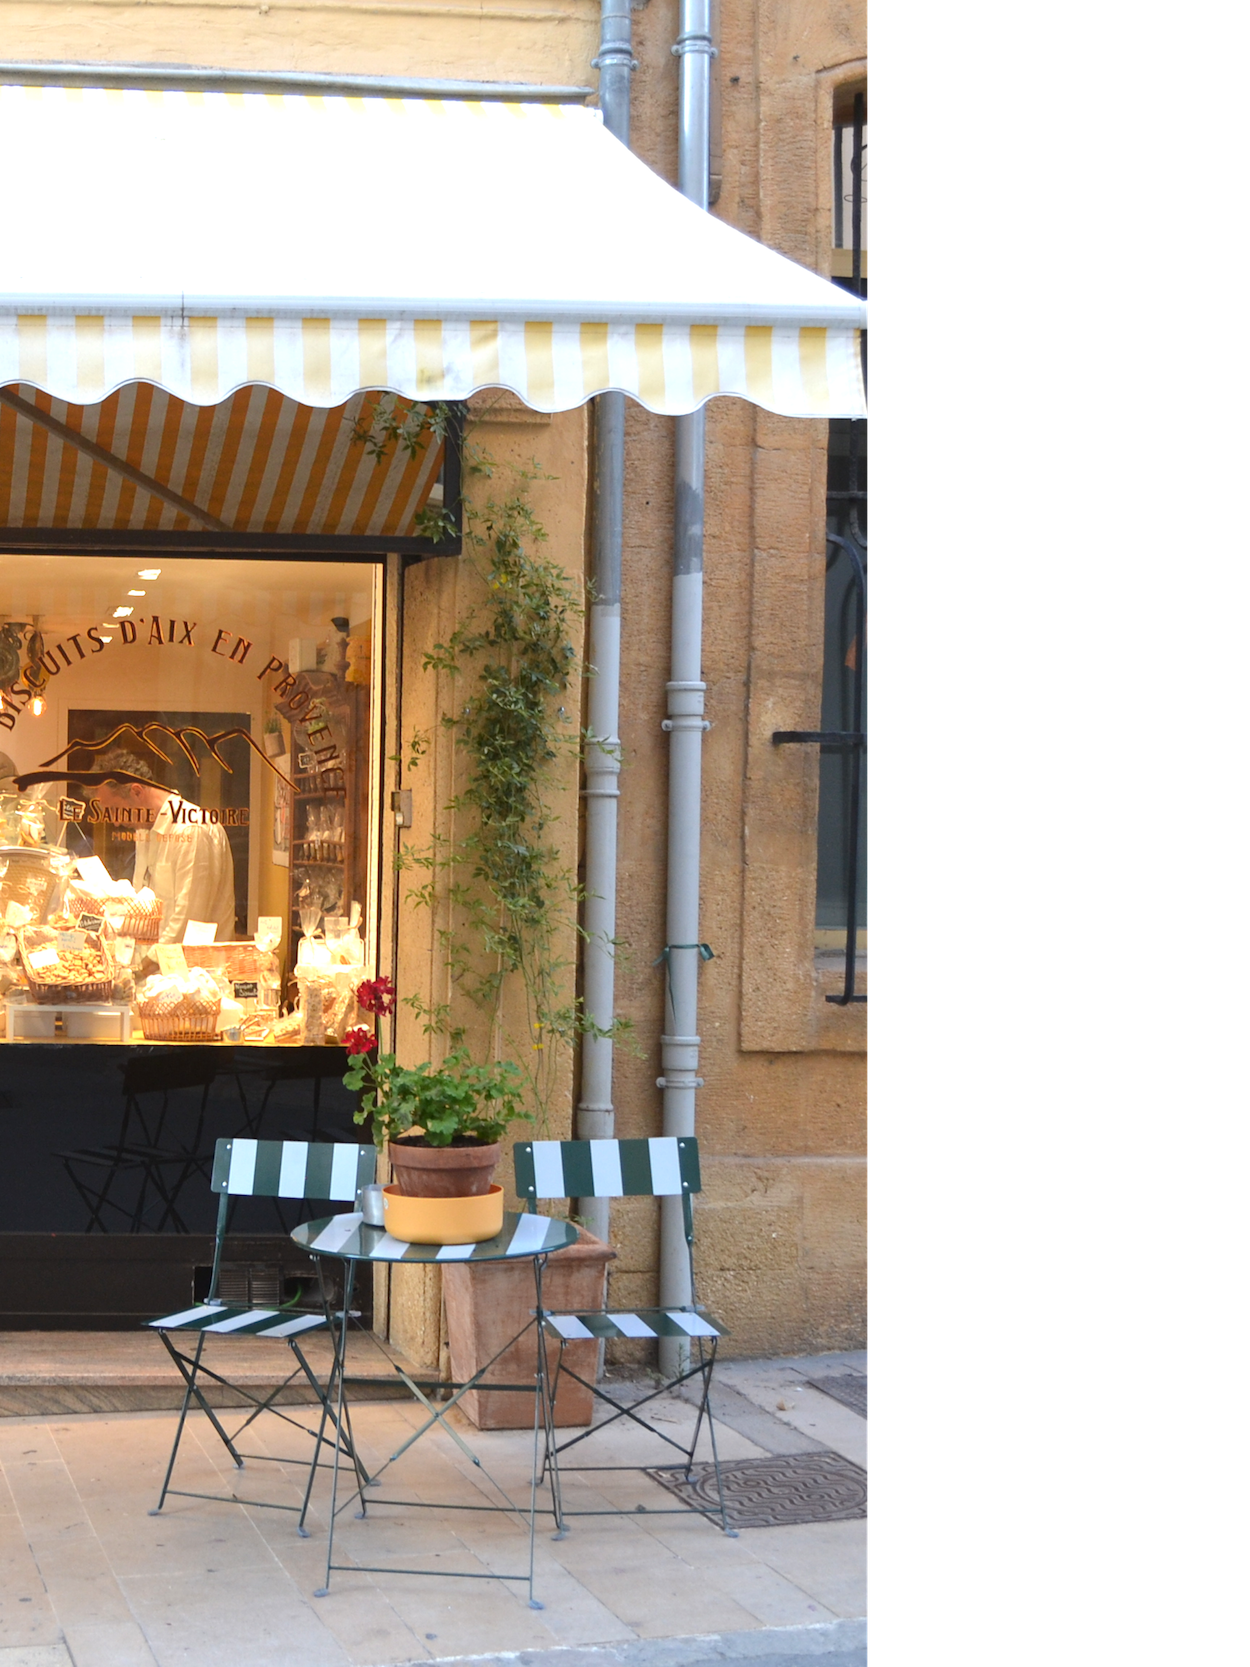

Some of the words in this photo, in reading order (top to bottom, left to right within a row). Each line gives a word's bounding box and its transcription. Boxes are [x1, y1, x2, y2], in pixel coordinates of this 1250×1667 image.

[119, 615, 197, 646] D'AIX
[211, 629, 253, 664] EN
[256, 655, 347, 799] PROVENCE
[58, 799, 83, 822] LE
